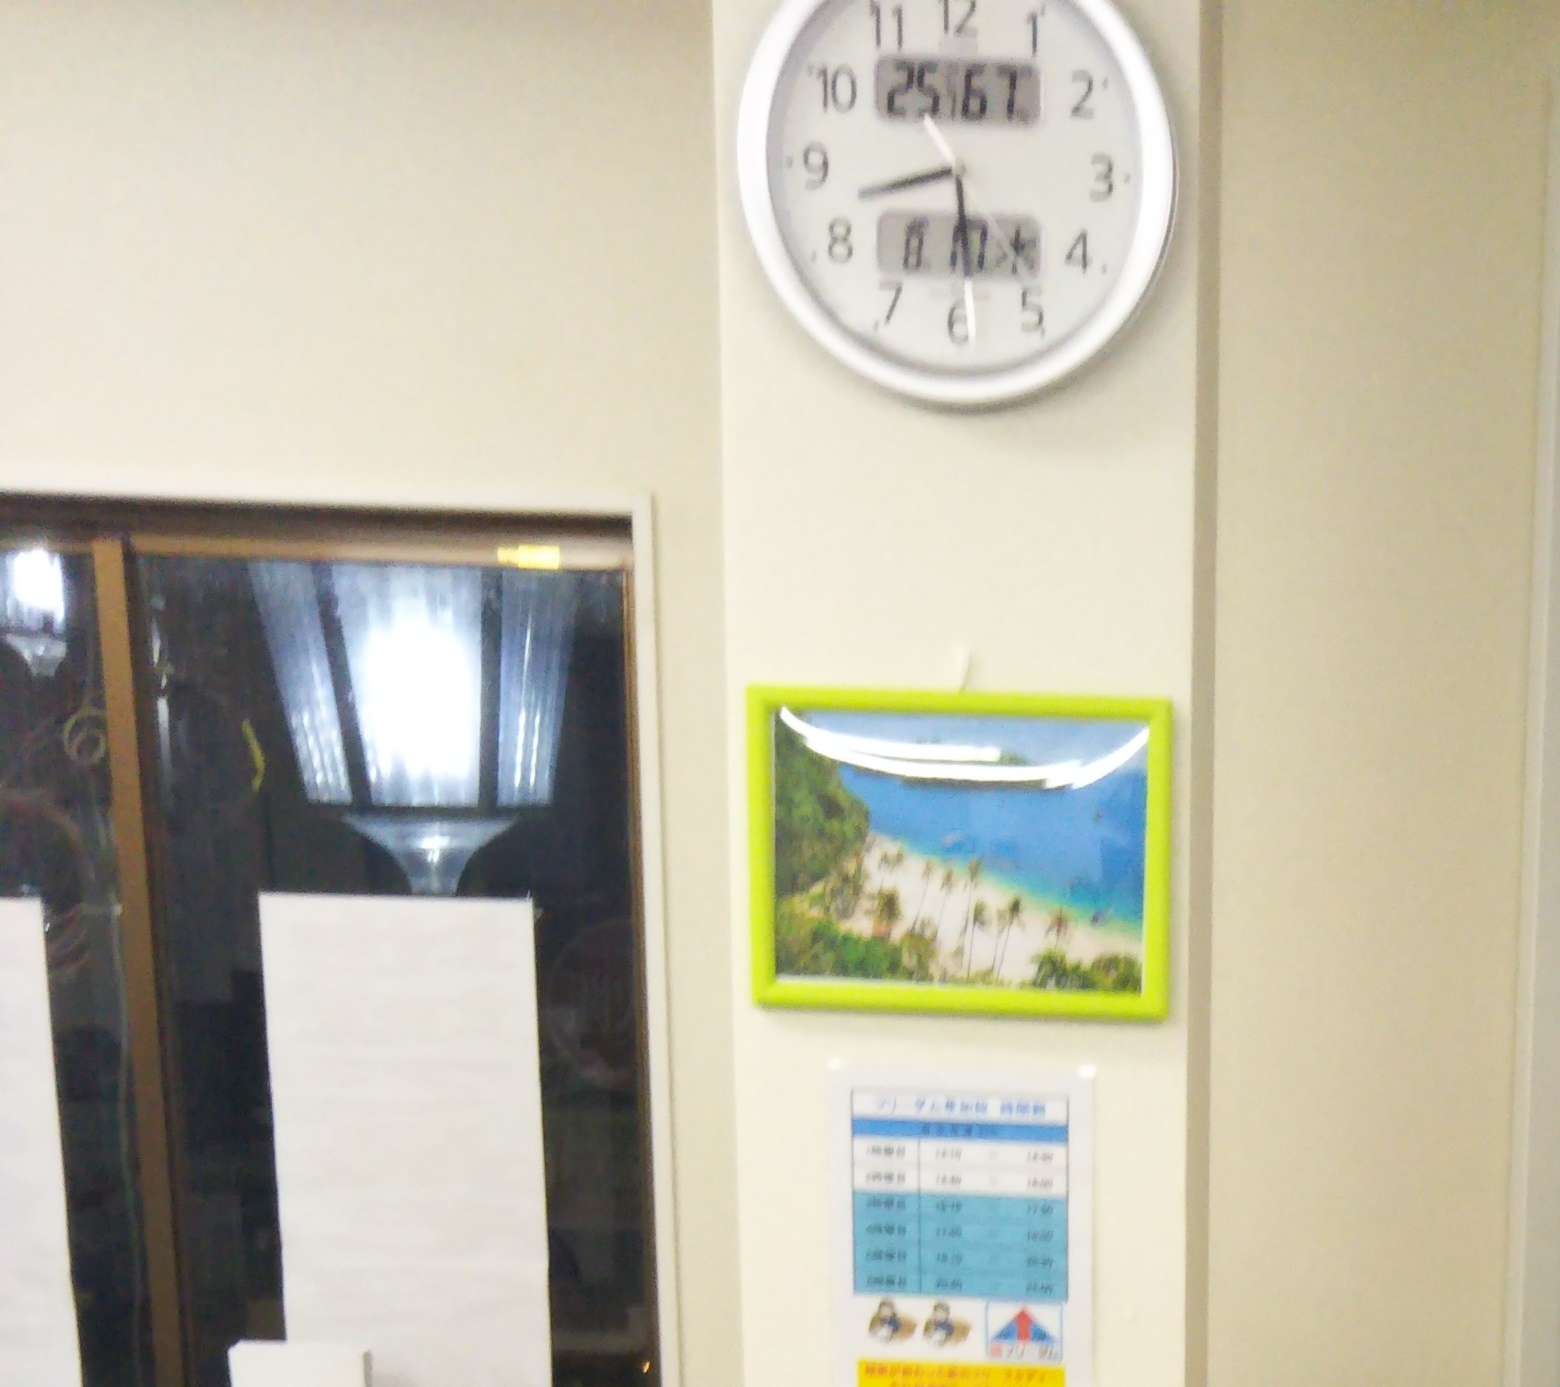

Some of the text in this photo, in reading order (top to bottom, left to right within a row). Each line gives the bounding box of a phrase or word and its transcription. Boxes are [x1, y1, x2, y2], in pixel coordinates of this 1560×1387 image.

[869, 2, 903, 48] 11
[938, 0, 978, 37] 12
[1026, 11, 1039, 56] 1
[815, 65, 858, 114] 10
[1071, 68, 1095, 120] 2
[802, 142, 830, 190] 9
[1089, 154, 1115, 202] 3
[827, 216, 854, 264] 8
[1064, 228, 1090, 274] 4
[879, 279, 903, 326] 7
[947, 303, 974, 346] 6
[1020, 284, 1045, 335] 5
